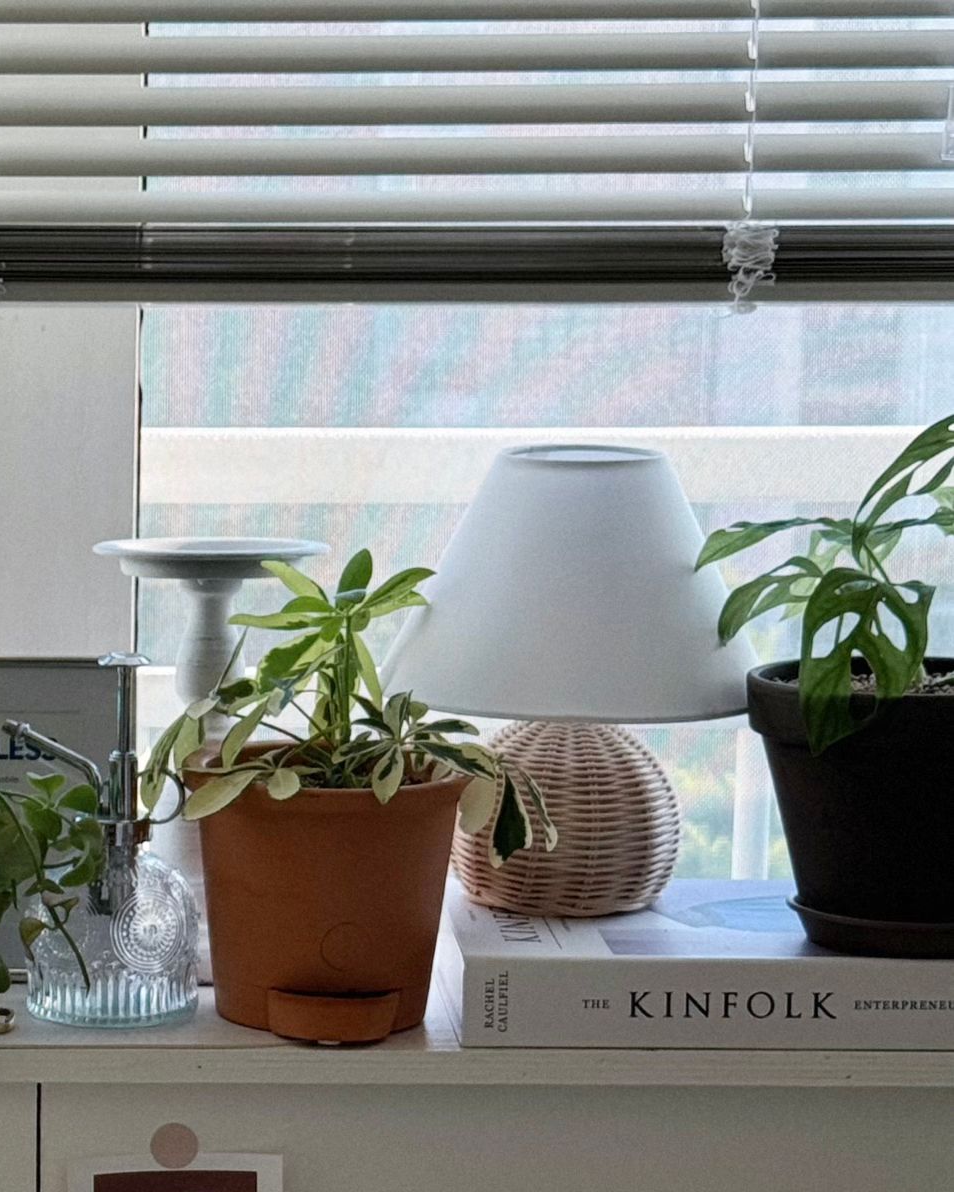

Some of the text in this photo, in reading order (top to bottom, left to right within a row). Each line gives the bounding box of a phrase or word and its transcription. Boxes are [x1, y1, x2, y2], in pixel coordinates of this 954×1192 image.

[490, 908, 542, 942] KINF
[484, 978, 495, 1028] RACHEL
[497, 970, 508, 1033] CAULFIEL
[582, 999, 610, 1010] THE
[628, 991, 837, 1019] KINFOLK
